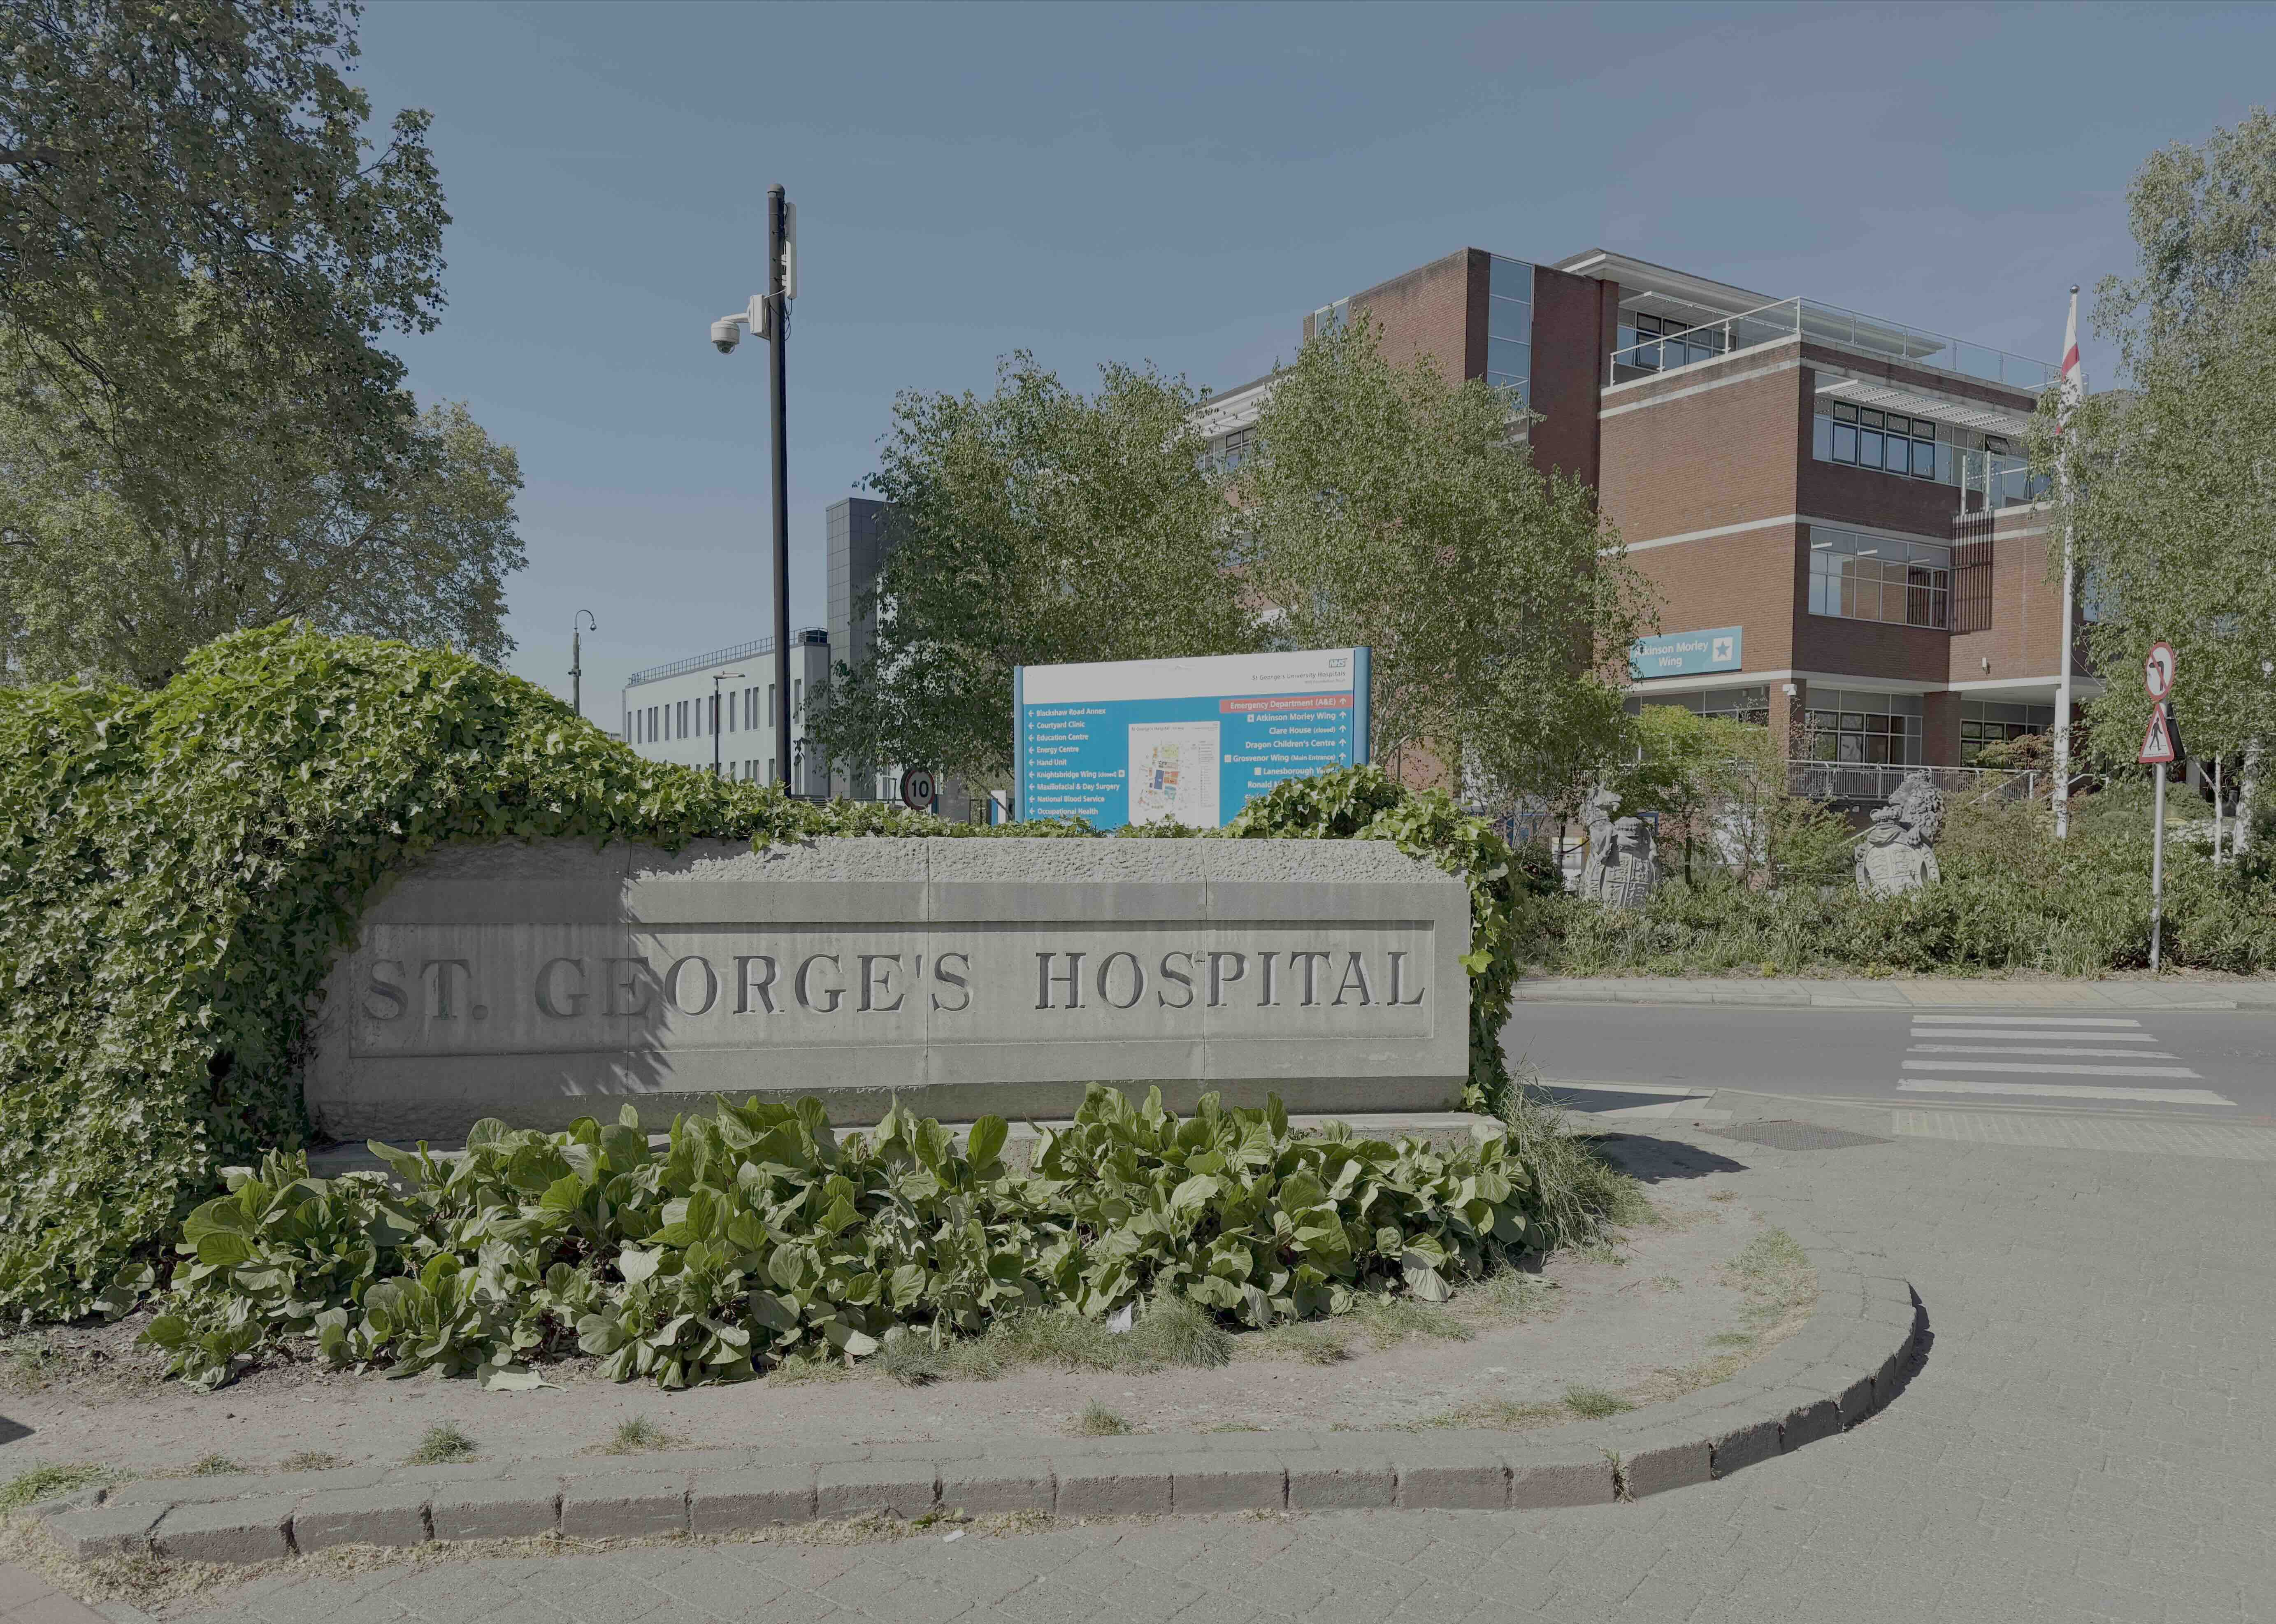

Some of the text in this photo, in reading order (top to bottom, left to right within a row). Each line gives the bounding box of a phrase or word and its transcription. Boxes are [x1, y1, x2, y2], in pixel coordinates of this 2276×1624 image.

[1635, 641, 1708, 657] Akinson Morley
[1658, 656, 1683, 668] Wing
[1270, 699, 1314, 709] Department
[1290, 713, 1315, 721] Morley
[1317, 712, 1336, 720] Wing
[1036, 721, 1066, 730] Courtyard
[1246, 741, 1271, 750] Dragon
[1273, 740, 1309, 748] Children's
[1271, 754, 1289, 762] Wing
[1263, 767, 1314, 776] Lanesborough
[1096, 783, 1119, 791] Surgery
[1247, 780, 1272, 788] Ronald
[912, 780, 929, 798] 10
[1038, 808, 1076, 816] Occupational
[362, 951, 1425, 1021] ST. GEORGE'S HOSPITAL
